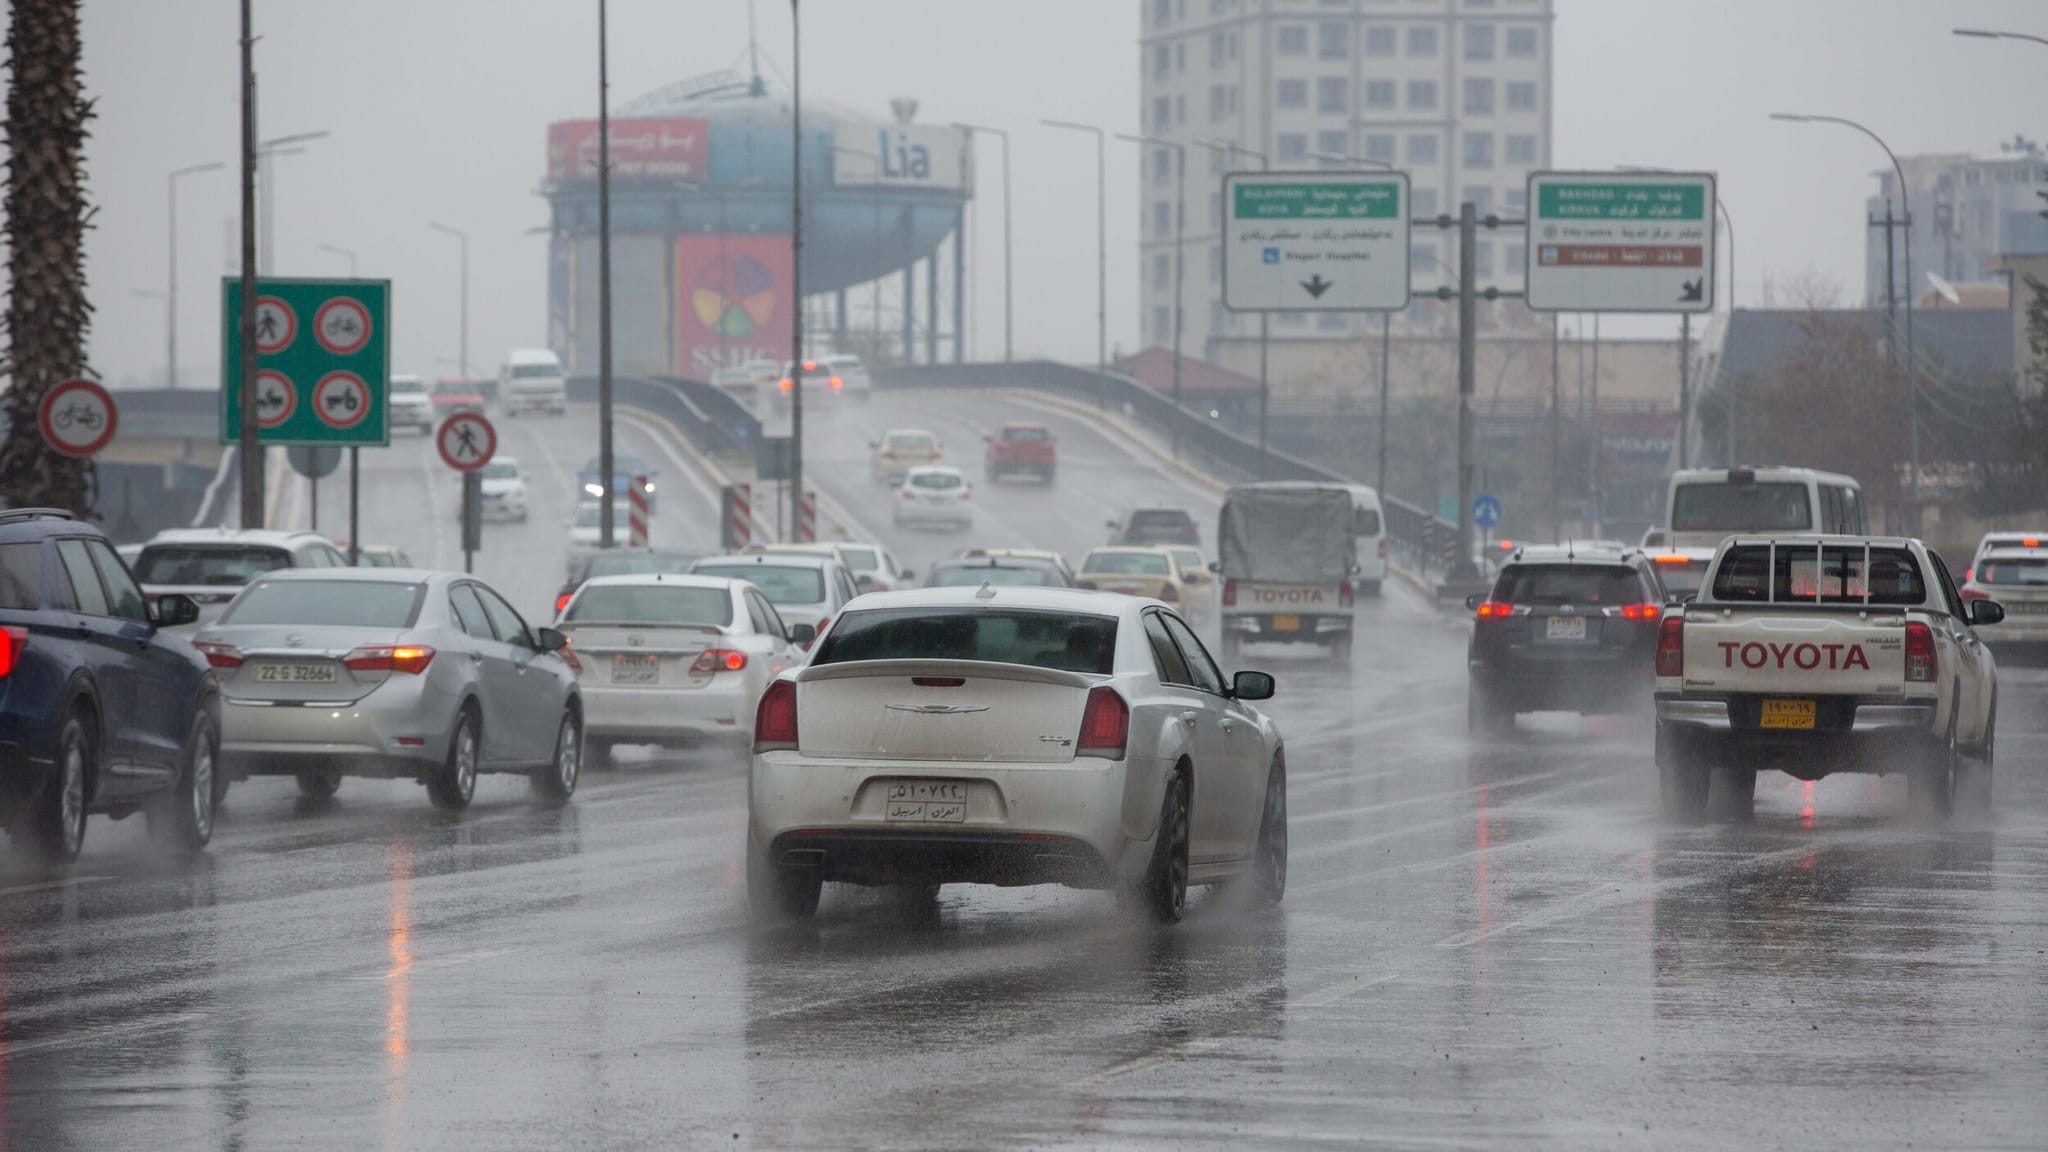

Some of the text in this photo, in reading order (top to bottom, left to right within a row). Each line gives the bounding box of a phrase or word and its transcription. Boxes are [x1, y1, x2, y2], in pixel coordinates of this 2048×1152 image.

[880, 127, 929, 178] Lia
[1251, 587, 1324, 604] TOYOTA
[1717, 642, 1870, 671] TOYOTA
